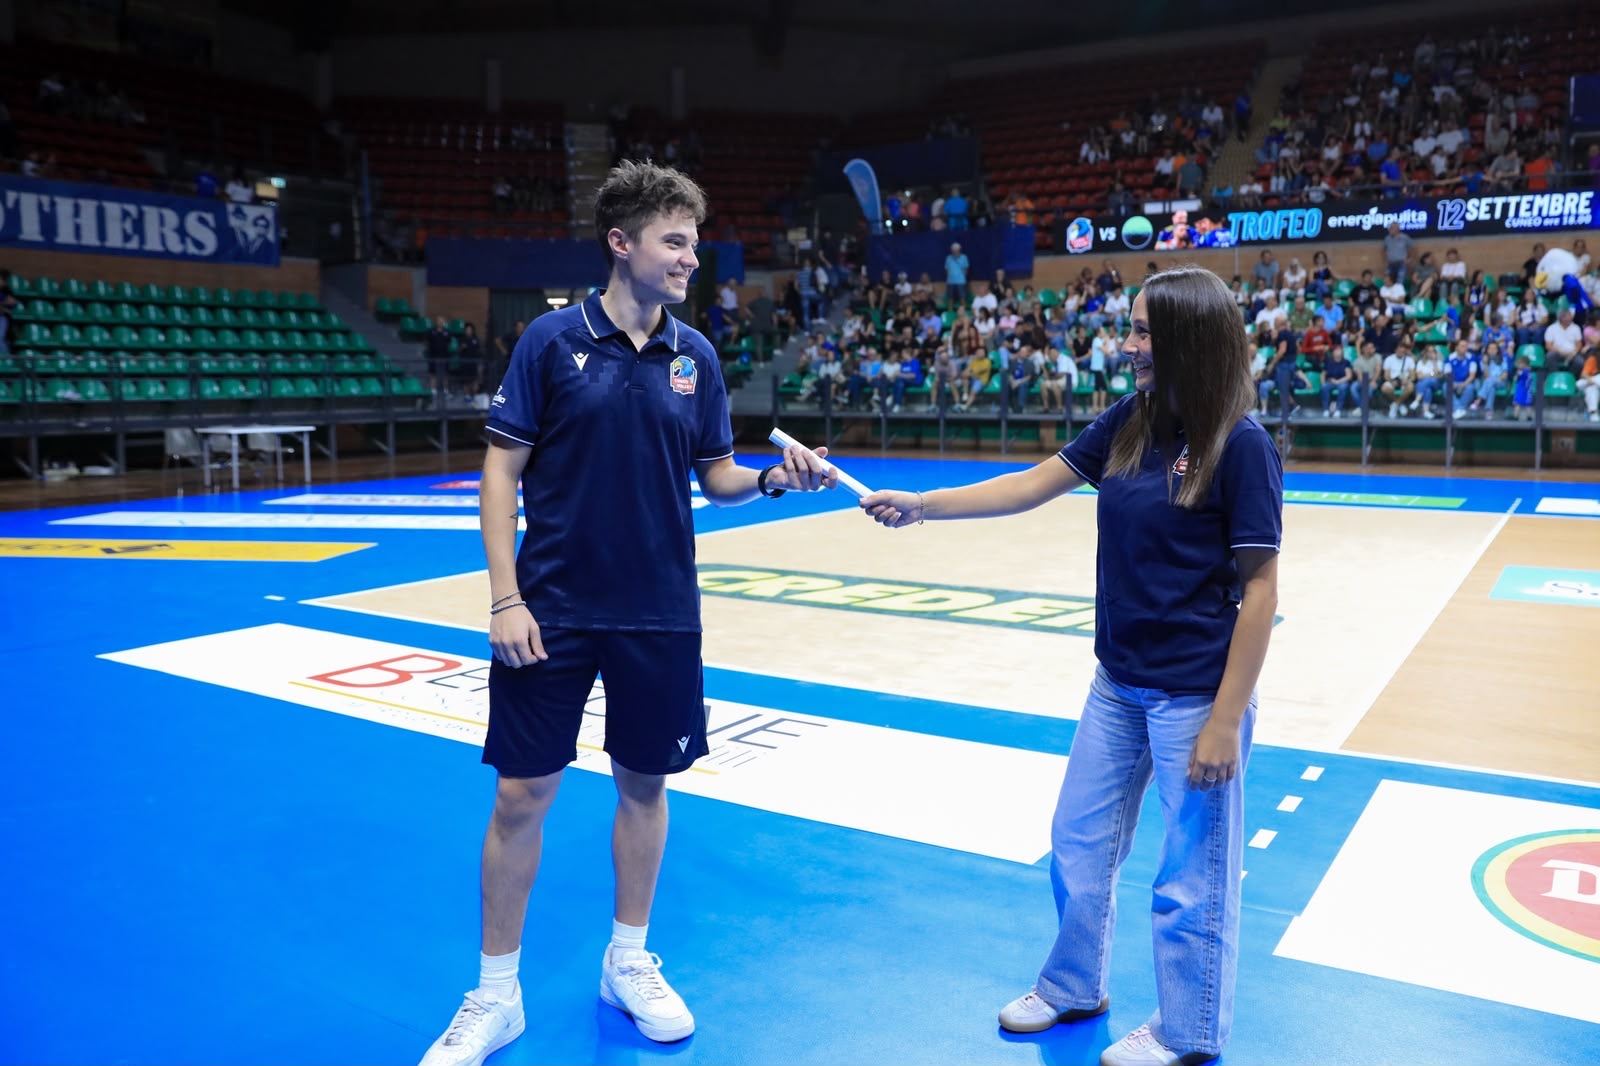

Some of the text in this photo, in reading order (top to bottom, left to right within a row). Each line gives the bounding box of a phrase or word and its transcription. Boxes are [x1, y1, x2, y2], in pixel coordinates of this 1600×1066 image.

[0, 190, 218, 256] THERS
[1227, 207, 1323, 241] TROFEO
[1437, 191, 1594, 231] 12 SETTEMBRE
[1099, 226, 1117, 242] VS
